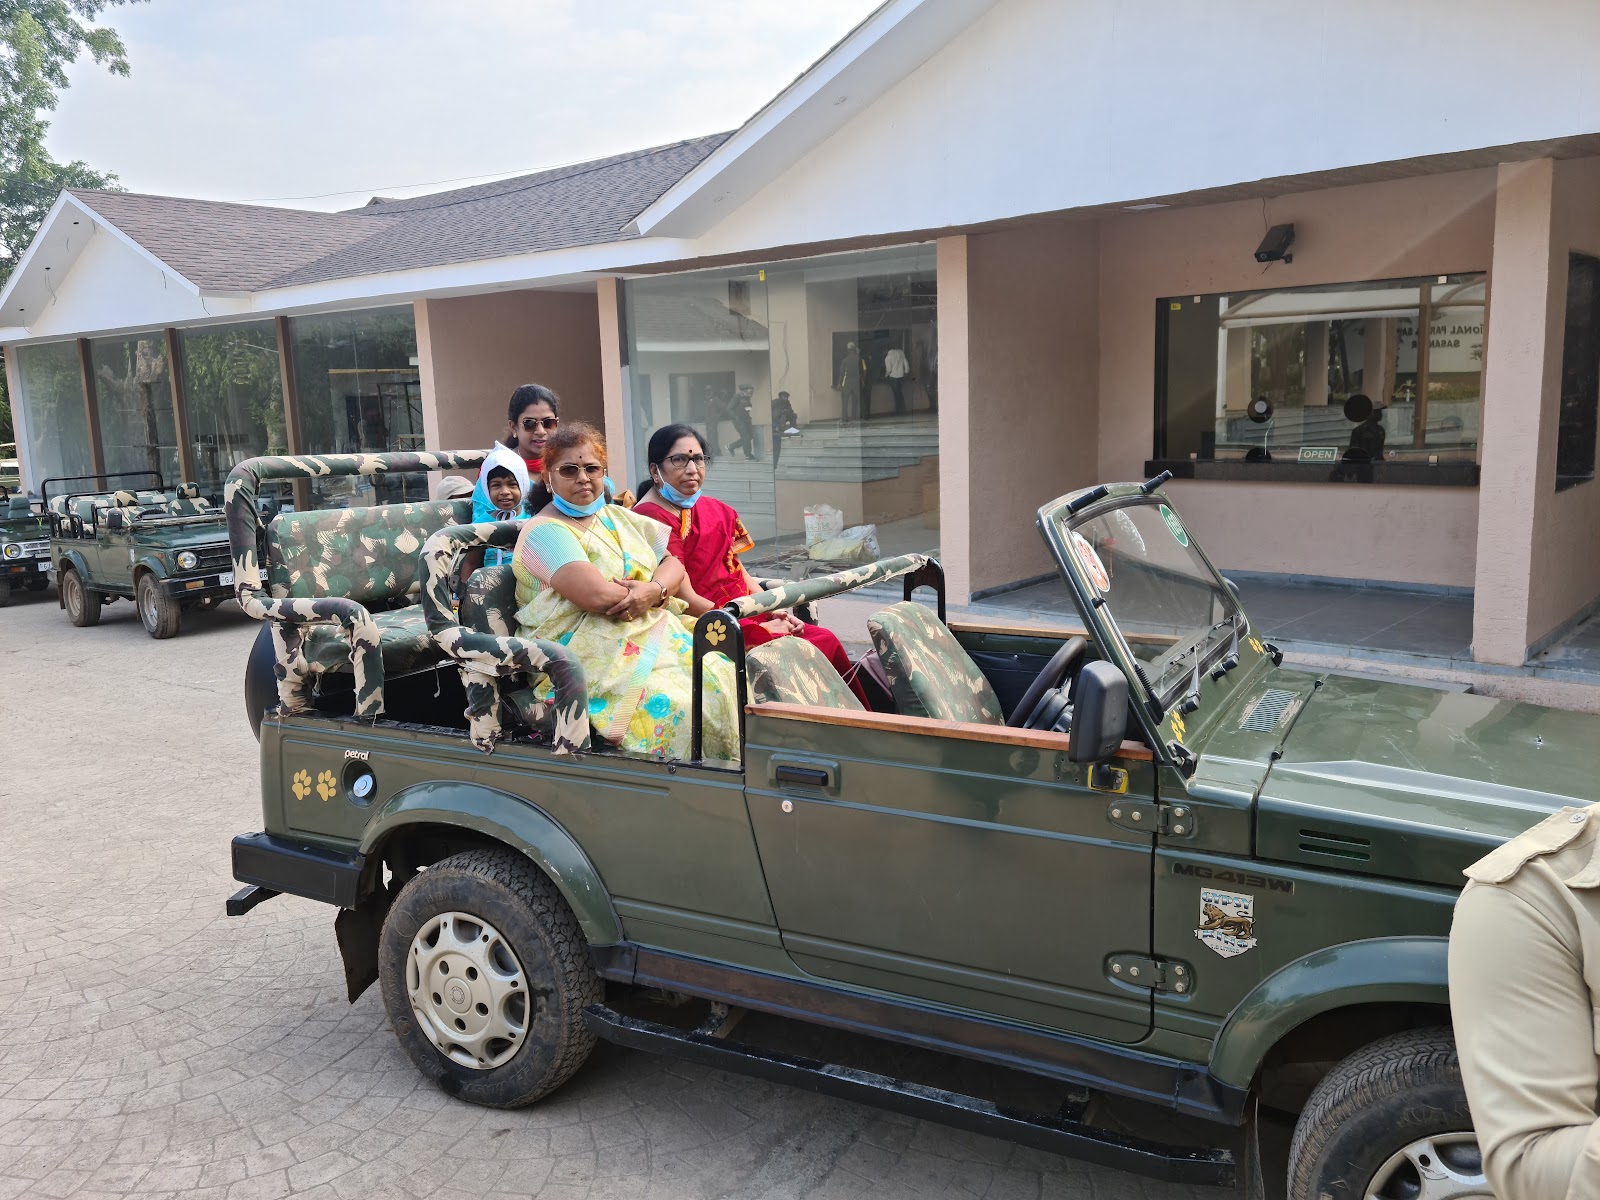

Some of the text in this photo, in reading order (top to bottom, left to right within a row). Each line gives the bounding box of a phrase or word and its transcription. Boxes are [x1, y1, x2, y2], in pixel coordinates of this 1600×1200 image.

[1303, 450, 1333, 459] OPEN
[344, 749, 370, 761] petrol
[1173, 862, 1294, 893] MG413W
[1202, 891, 1252, 909] GYPSY
